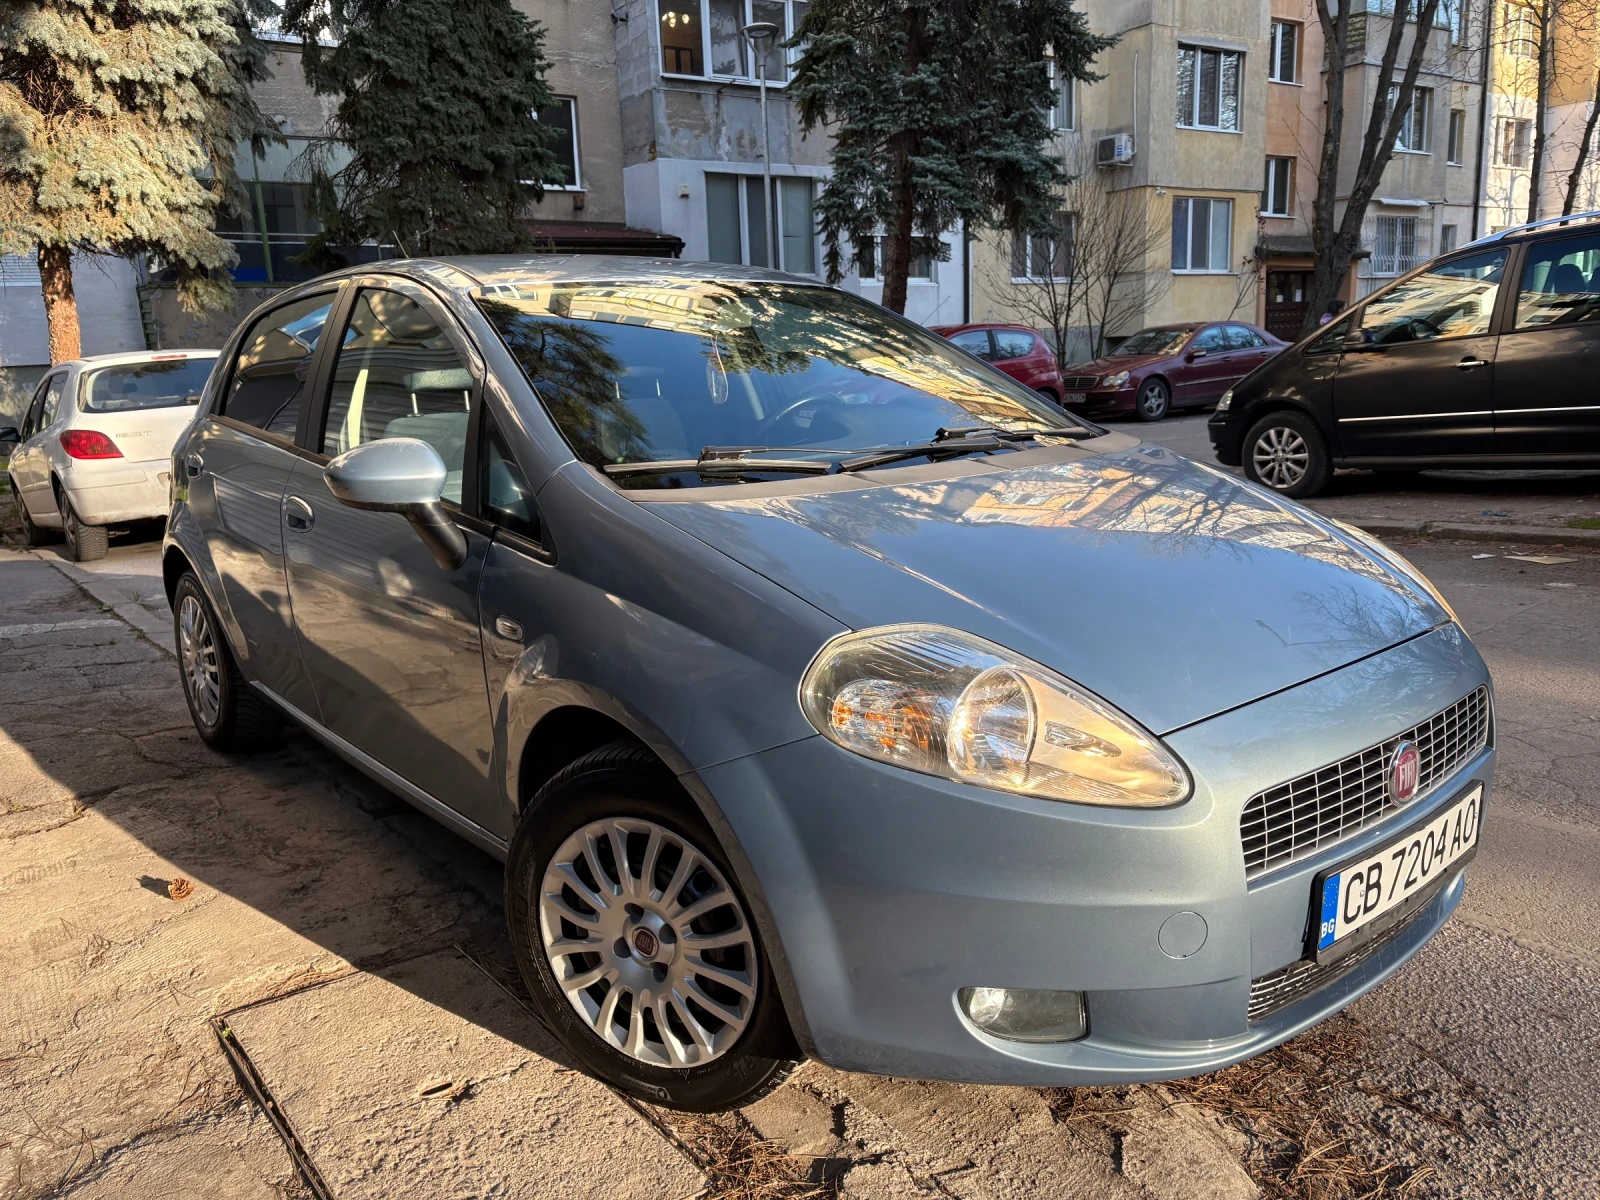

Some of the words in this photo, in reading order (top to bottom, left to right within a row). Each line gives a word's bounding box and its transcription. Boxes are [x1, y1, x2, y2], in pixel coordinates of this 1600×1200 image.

[1398, 759, 1417, 792] FIAT
[1343, 861, 1383, 925] CB
[1387, 819, 1449, 902] 7204
[1449, 798, 1476, 859] AO
[1321, 918, 1335, 937] BG
